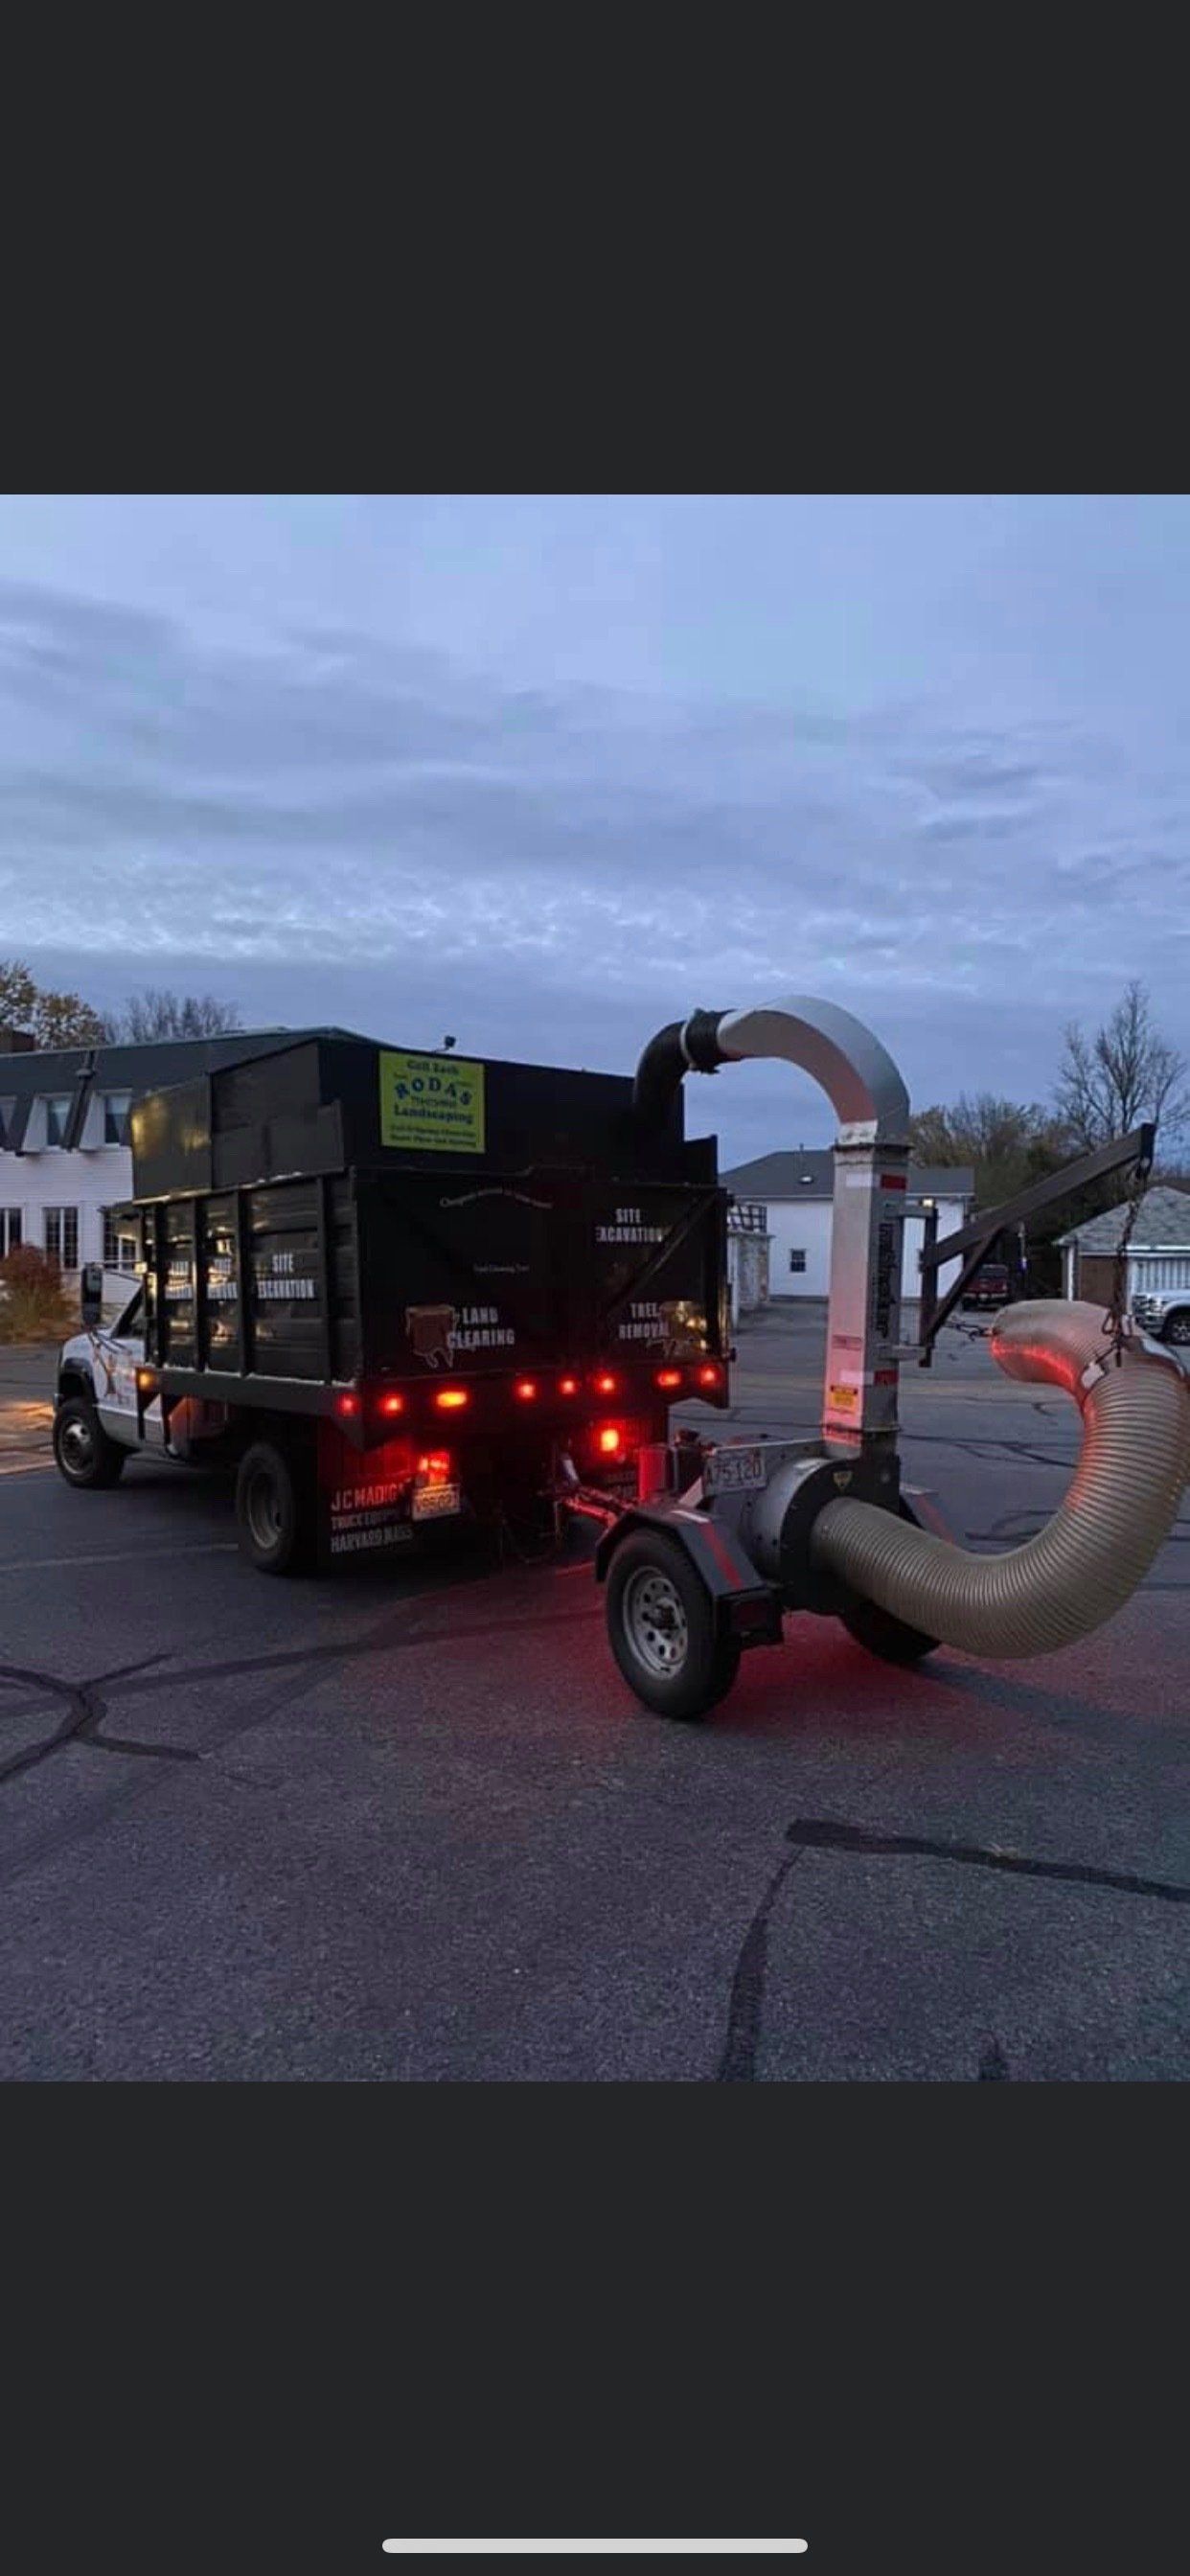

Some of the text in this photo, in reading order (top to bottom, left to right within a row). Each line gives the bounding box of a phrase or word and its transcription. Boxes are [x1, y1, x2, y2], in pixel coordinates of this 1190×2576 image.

[614, 1208, 641, 1224] SITE
[272, 1253, 293, 1274] SITE
[257, 1278, 314, 1300] EXCAVATION
[462, 1306, 499, 1324] LAND
[446, 1328, 515, 1349] CLEARING
